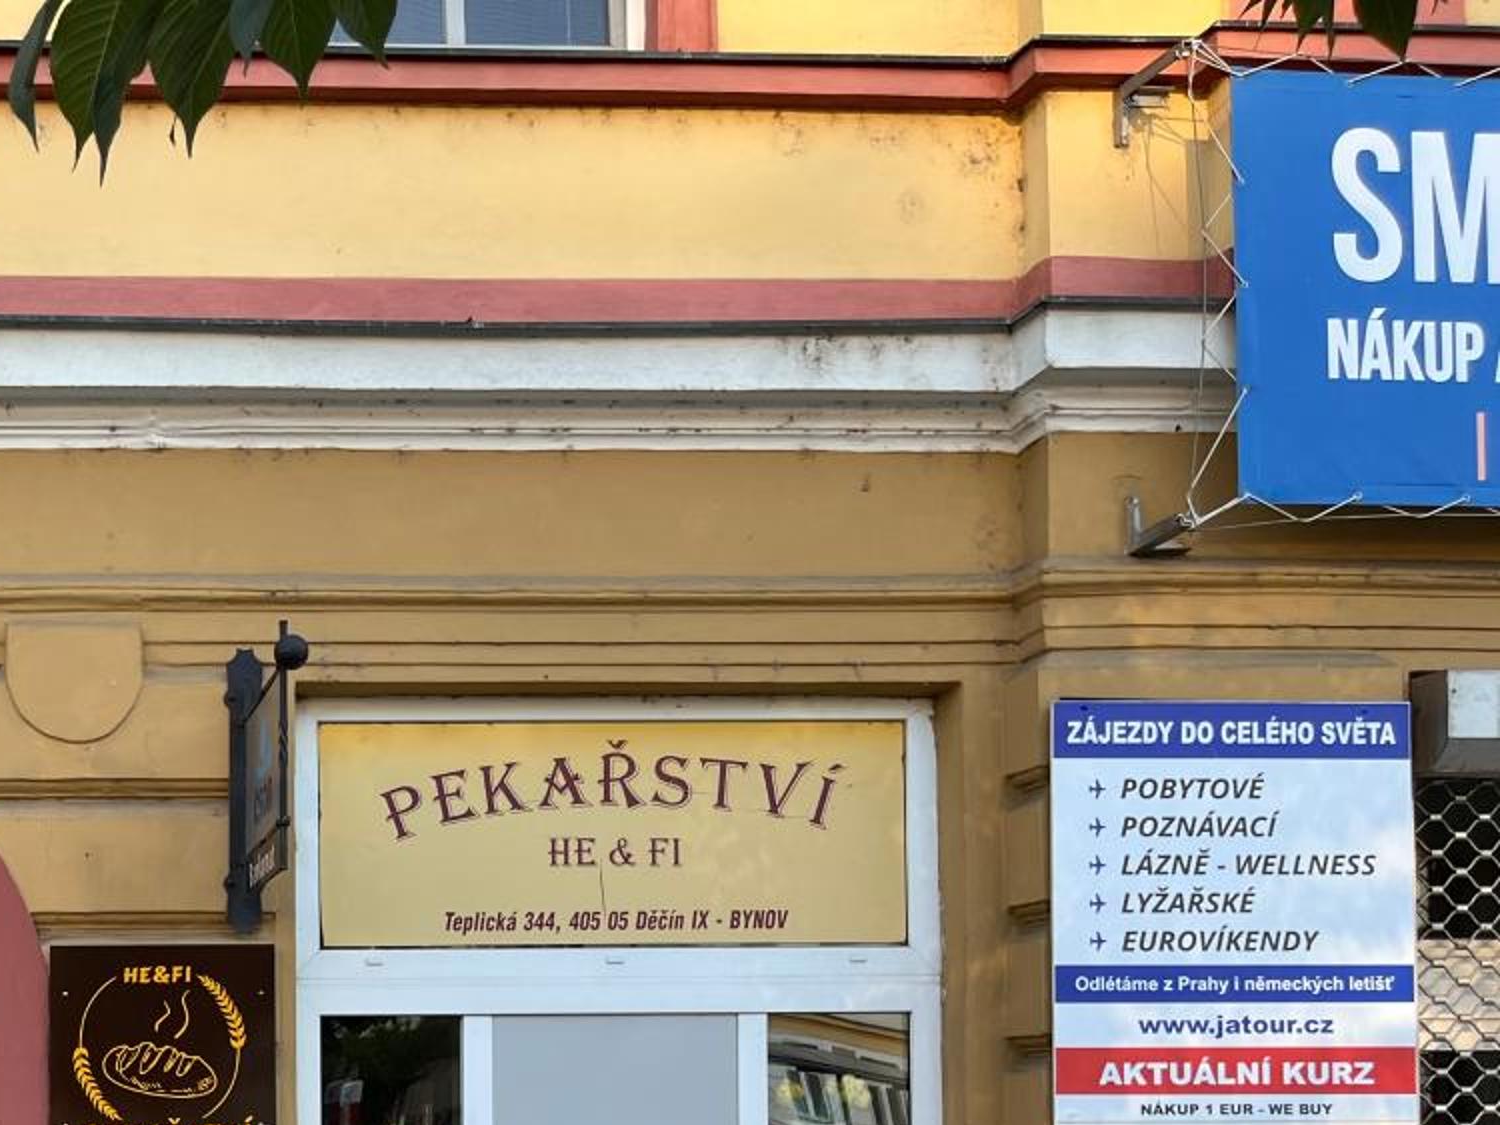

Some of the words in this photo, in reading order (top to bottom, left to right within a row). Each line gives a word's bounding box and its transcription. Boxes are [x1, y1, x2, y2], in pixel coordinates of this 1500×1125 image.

[1326, 307, 1485, 382] NÁKUP
[1067, 715, 1174, 745] ZÁJEZDY
[1181, 721, 1214, 745] DO
[1221, 715, 1315, 745] CELÉHO
[1321, 716, 1397, 745] SVĚTA
[380, 739, 843, 841] PEKAŘSTVÍ
[1120, 772, 1265, 800] POBYTOVÉ
[1121, 810, 1280, 838] POZNÁVACÍ
[547, 837, 598, 867] HE
[608, 838, 635, 866] &
[649, 837, 682, 866] FI
[1121, 848, 1210, 876] LÁZNĚ
[1235, 854, 1376, 876] WELLNESS
[1121, 886, 1256, 914] LYŽAŘSKÉ
[445, 911, 518, 937] Teplická
[523, 911, 561, 933] 344,
[568, 911, 602, 932] 405
[607, 911, 629, 931] 05
[635, 909, 685, 931] Děčín
[691, 910, 709, 930] IX
[729, 909, 789, 930] BYNOV
[1122, 925, 1320, 953] EUROVÍKENDY
[123, 965, 191, 984] HE&FI
[1075, 975, 1159, 992] Odlétáme
[1163, 979, 1174, 991] z
[1177, 975, 1229, 995] Prahy
[1233, 975, 1240, 991] i
[1244, 975, 1345, 995] německých
[1349, 975, 1395, 991] letišť
[1138, 1014, 1334, 1040] www.jatour.cz
[1099, 1055, 1271, 1086] AKTUÁLNÍ
[1282, 1061, 1375, 1085] KURZ
[1140, 1103, 1199, 1116] NÁKUP
[1205, 1103, 1213, 1115] 1
[1219, 1103, 1253, 1116] EUR
[1267, 1103, 1293, 1115] WE
[1299, 1103, 1333, 1115] BUY
